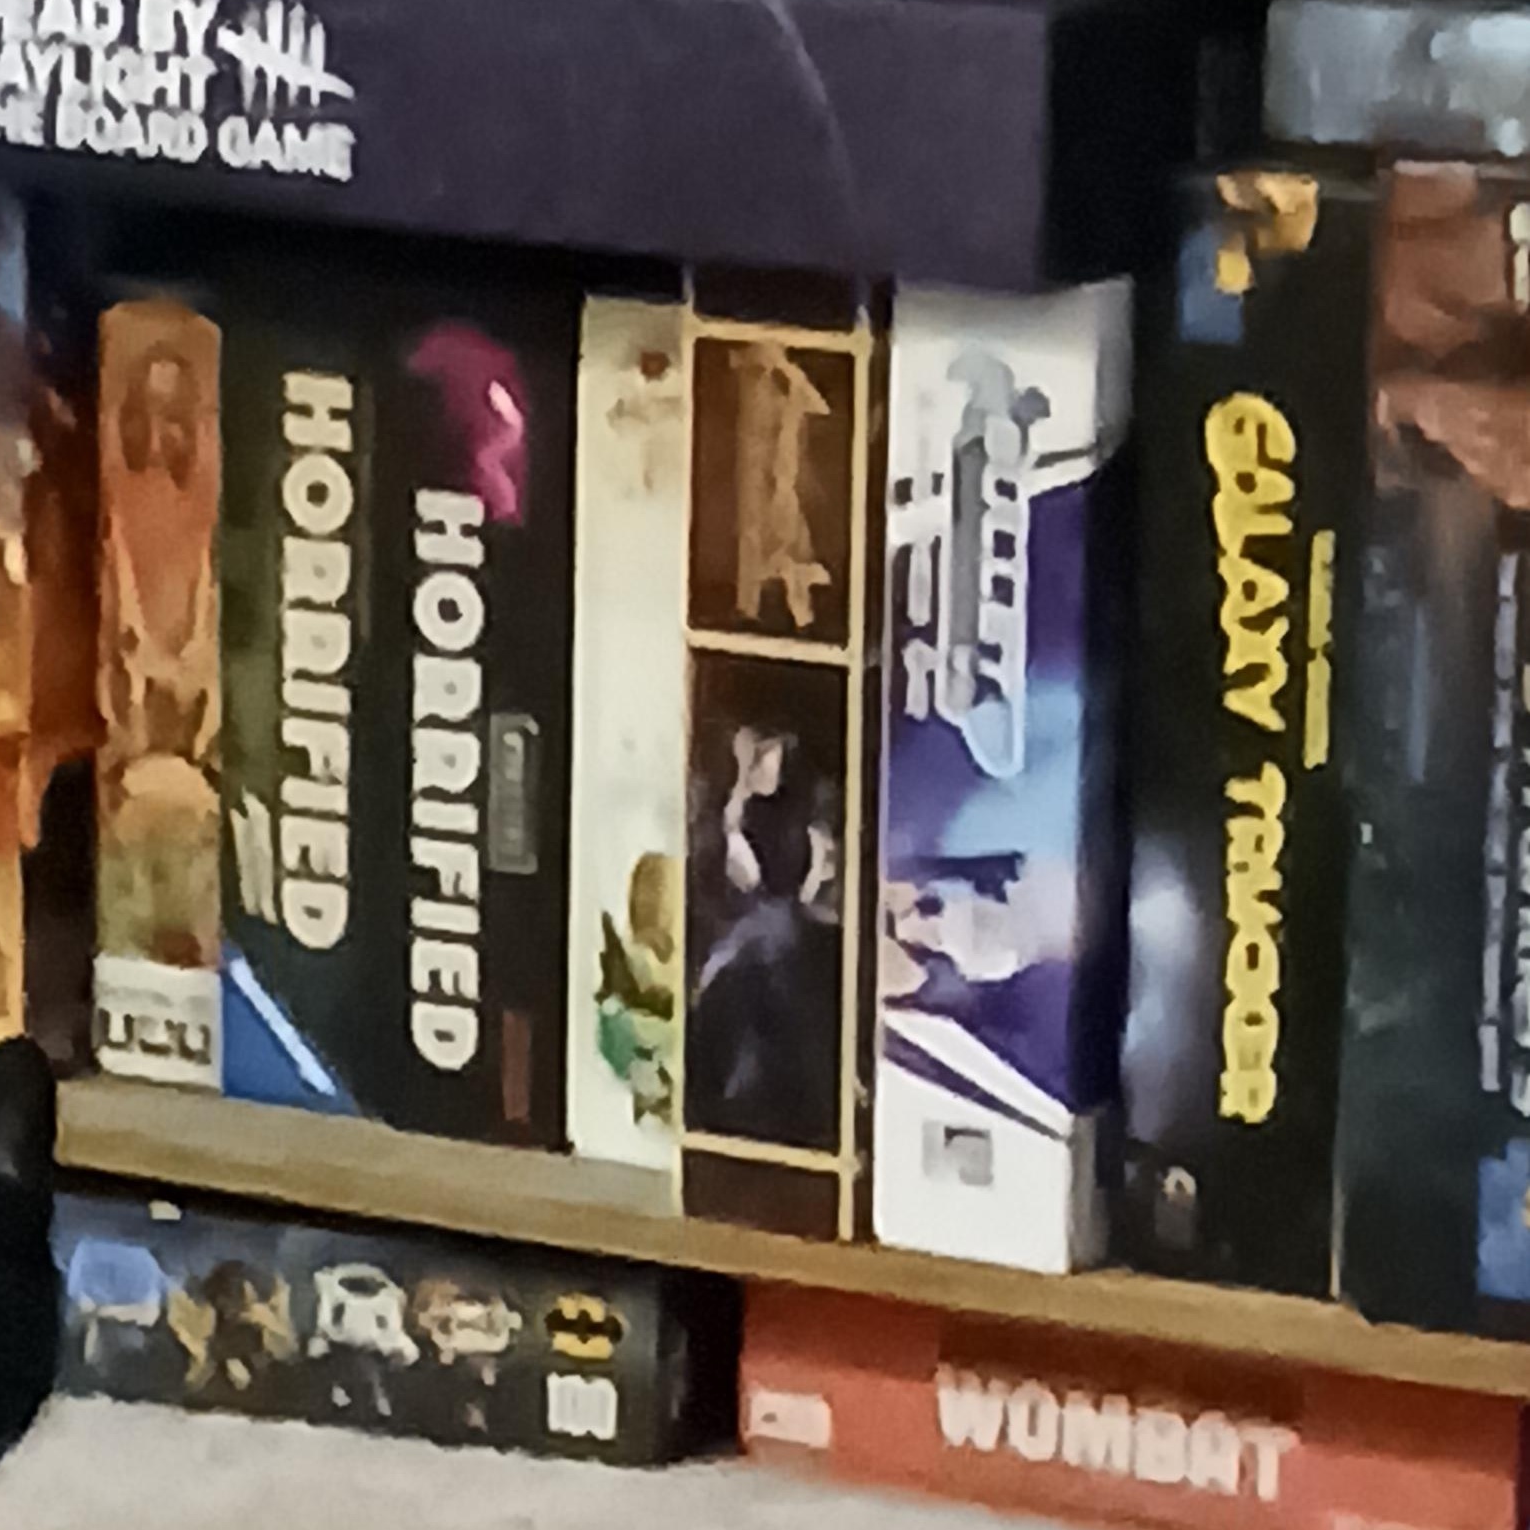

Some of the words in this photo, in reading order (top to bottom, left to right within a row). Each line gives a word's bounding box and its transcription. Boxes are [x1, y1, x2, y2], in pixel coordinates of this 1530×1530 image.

[55, 98, 208, 163] BOARD
[217, 115, 356, 182] GAME
[282, 369, 354, 950] HORRIFIED
[1204, 392, 1297, 732] GALAXY
[410, 487, 485, 1072] HORRIFIED
[1219, 761, 1288, 1126] TRUCKER
[935, 1362, 1301, 1501] WOMBAT
